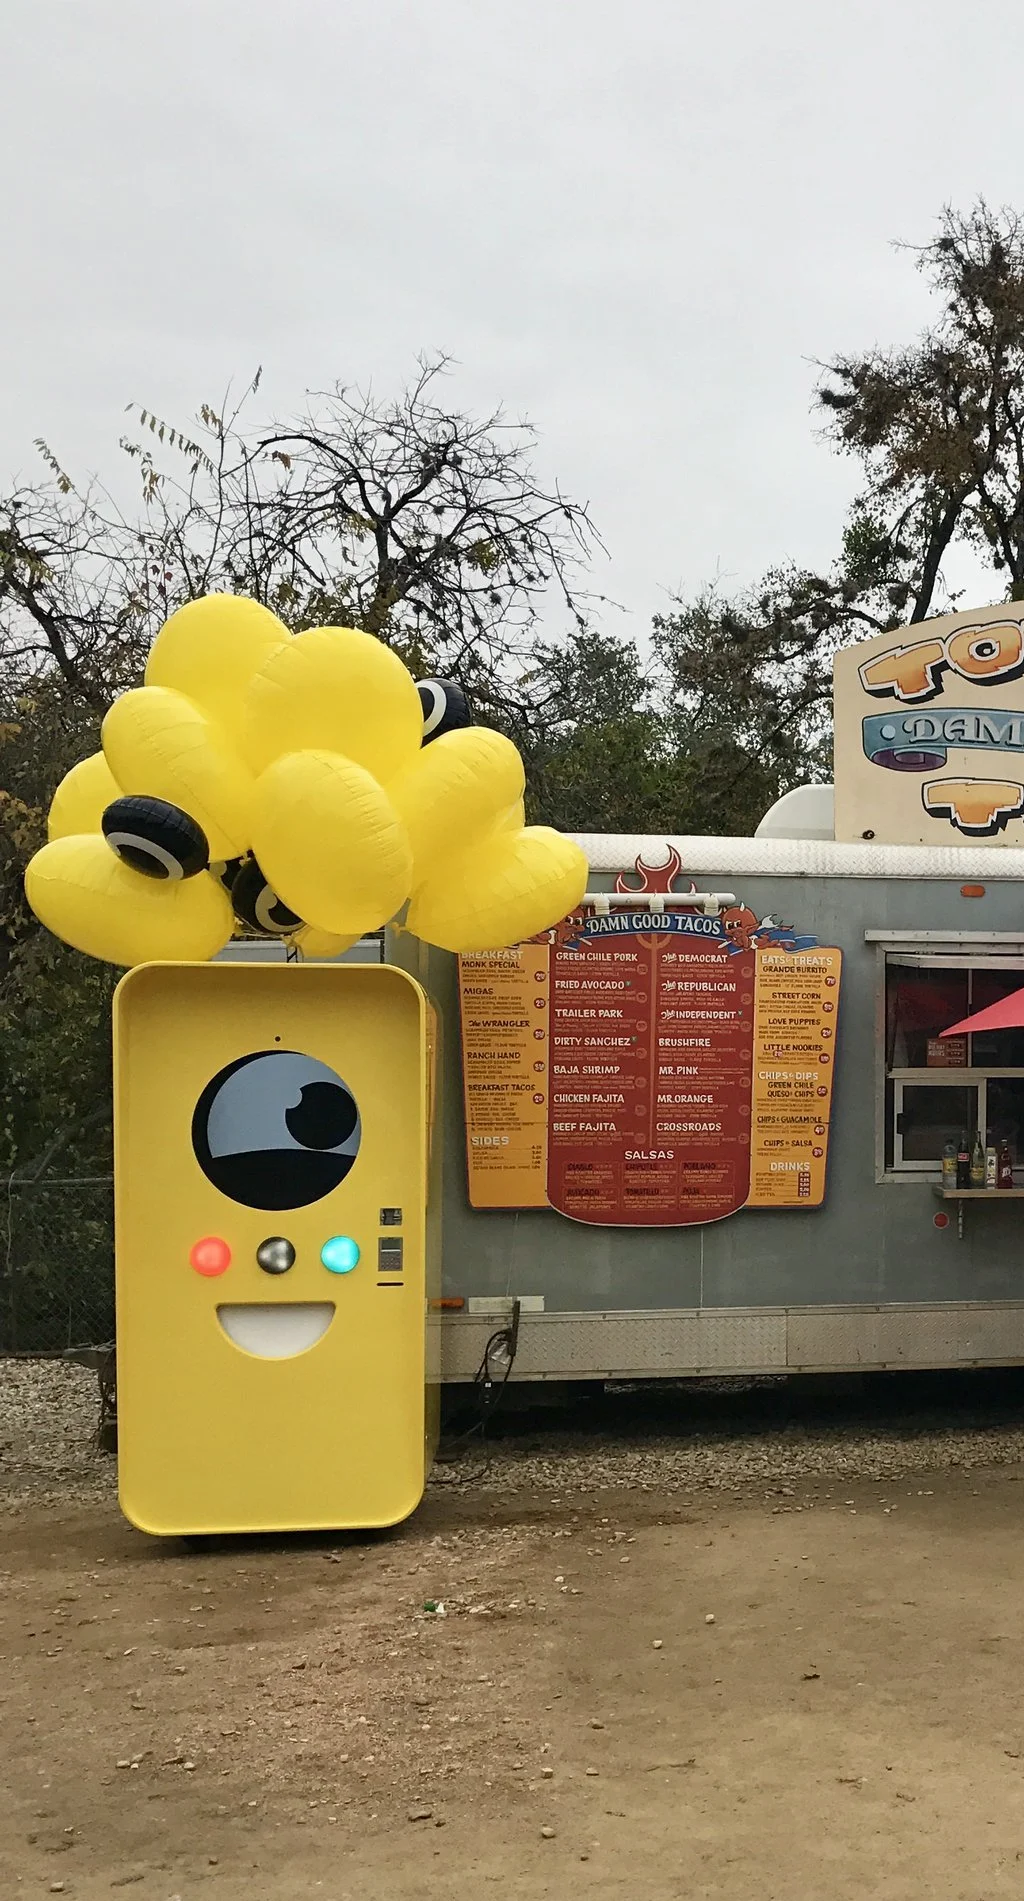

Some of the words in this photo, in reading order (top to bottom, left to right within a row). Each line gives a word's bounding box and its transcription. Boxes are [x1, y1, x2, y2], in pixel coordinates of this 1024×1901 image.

[586, 916, 629, 933] DAMN
[633, 914, 670, 929] GOOD
[675, 916, 720, 935] TACOS
[461, 951, 523, 960] BREAKFAST
[556, 952, 585, 961] GREEN
[587, 952, 612, 961] CHILE
[614, 953, 638, 961] PORK
[678, 954, 728, 963] DEMOCRAT
[488, 961, 520, 969] SPECIAL
[761, 955, 786, 964] EATS
[792, 956, 833, 966] TREATS
[555, 980, 580, 989] FRIED
[581, 980, 625, 990] AVOCADO
[678, 982, 736, 992] REPUBLICAN
[555, 1009, 596, 1018] TRAILER
[598, 1009, 623, 1018] PARK
[676, 1011, 736, 1020] INDEPENDENT
[482, 1020, 530, 1028] WRANGLER
[554, 1036, 582, 1046] DIRTY
[584, 1037, 631, 1046] SANCHEZ
[659, 1038, 711, 1047] BRUSHFIRE
[553, 1065, 580, 1074] BAJA
[582, 1065, 621, 1074] SHRIMP
[758, 1072, 789, 1080] CHIPS
[795, 1072, 819, 1080] DIPS
[553, 1094, 591, 1103] CHICKEN
[592, 1094, 625, 1103] FAJITA
[781, 1116, 822, 1124] GUACAMOLE
[553, 1123, 577, 1132] BEEF
[579, 1123, 616, 1132] FAJITA
[656, 1122, 722, 1132] CROSSROADS
[472, 1136, 510, 1146] SIDES
[624, 1150, 675, 1160] SALSAS
[770, 1162, 810, 1171] DRINKS
